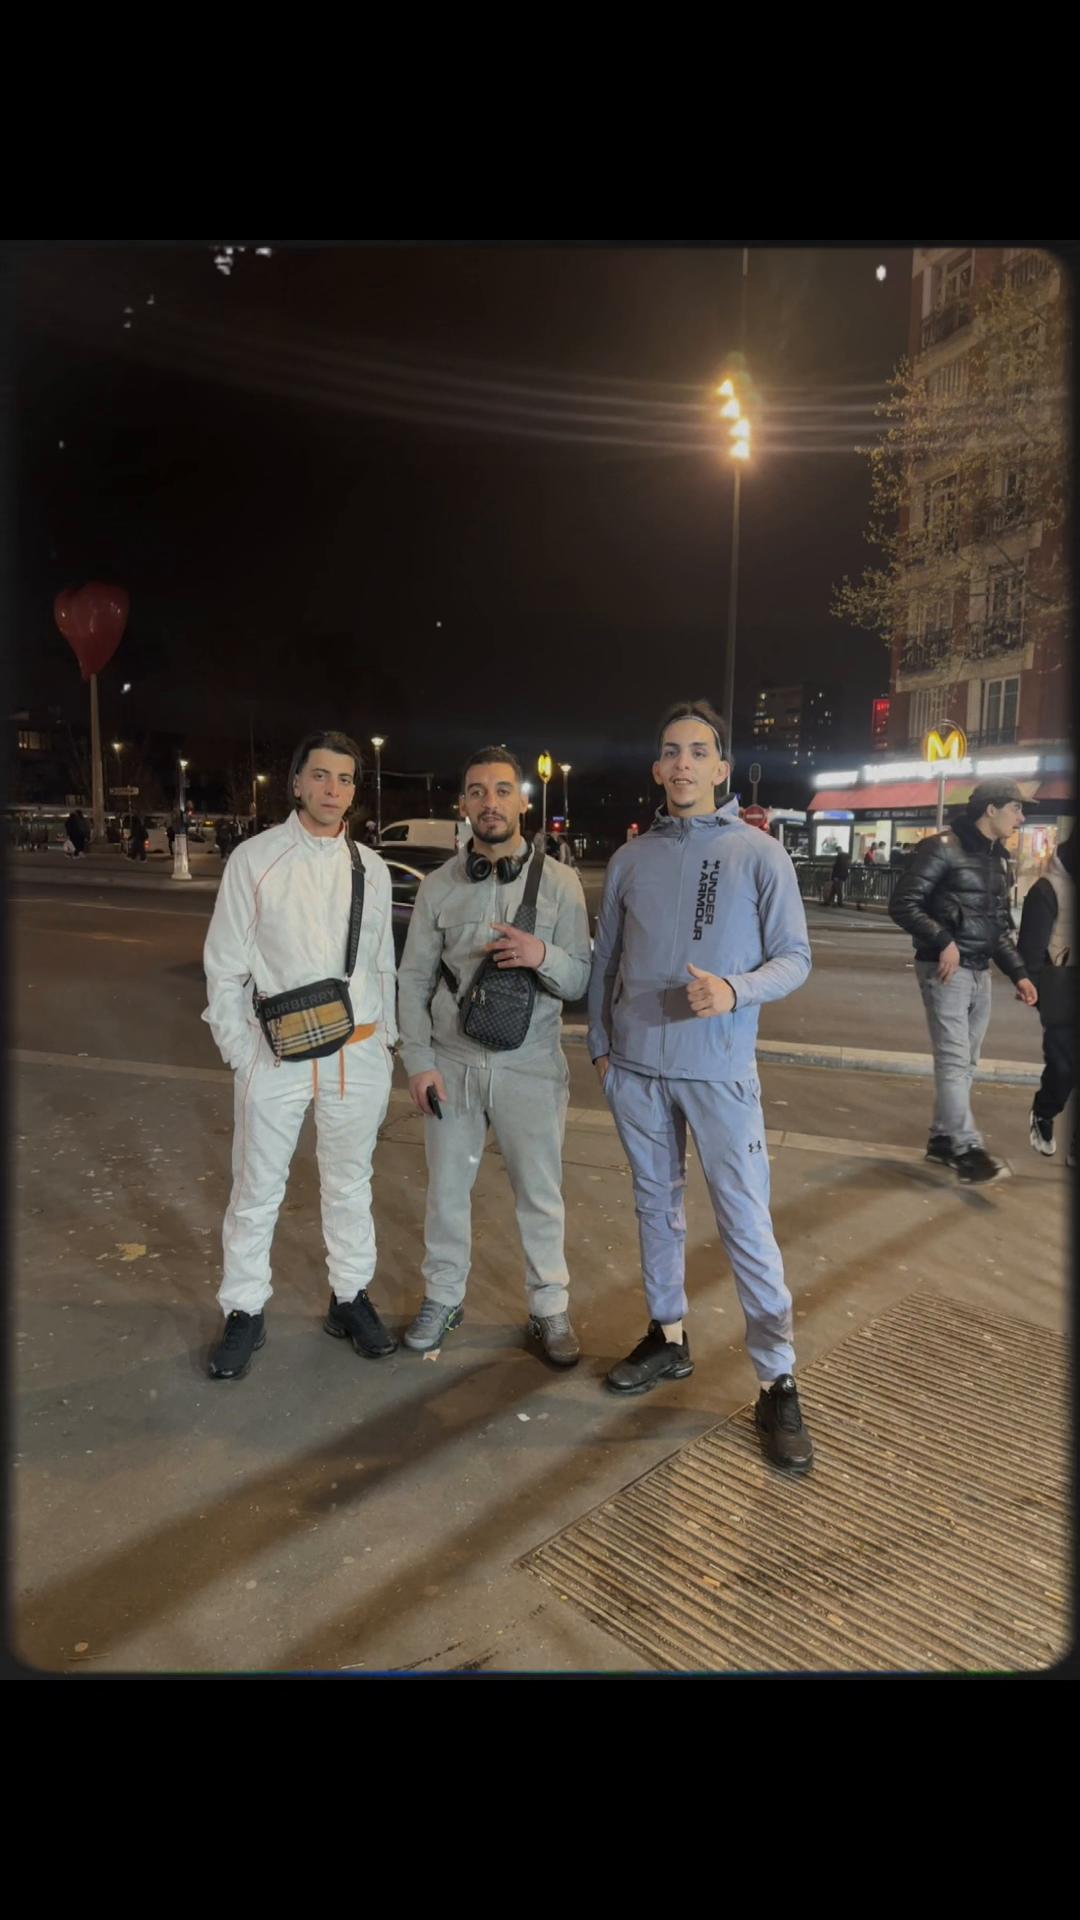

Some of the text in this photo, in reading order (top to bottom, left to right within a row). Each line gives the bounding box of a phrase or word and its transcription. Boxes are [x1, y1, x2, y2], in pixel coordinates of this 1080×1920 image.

[928, 730, 960, 765] M
[692, 872, 709, 941] ARMOUR
[704, 871, 719, 925] UNDER
[264, 988, 335, 1019] BURBERRY
